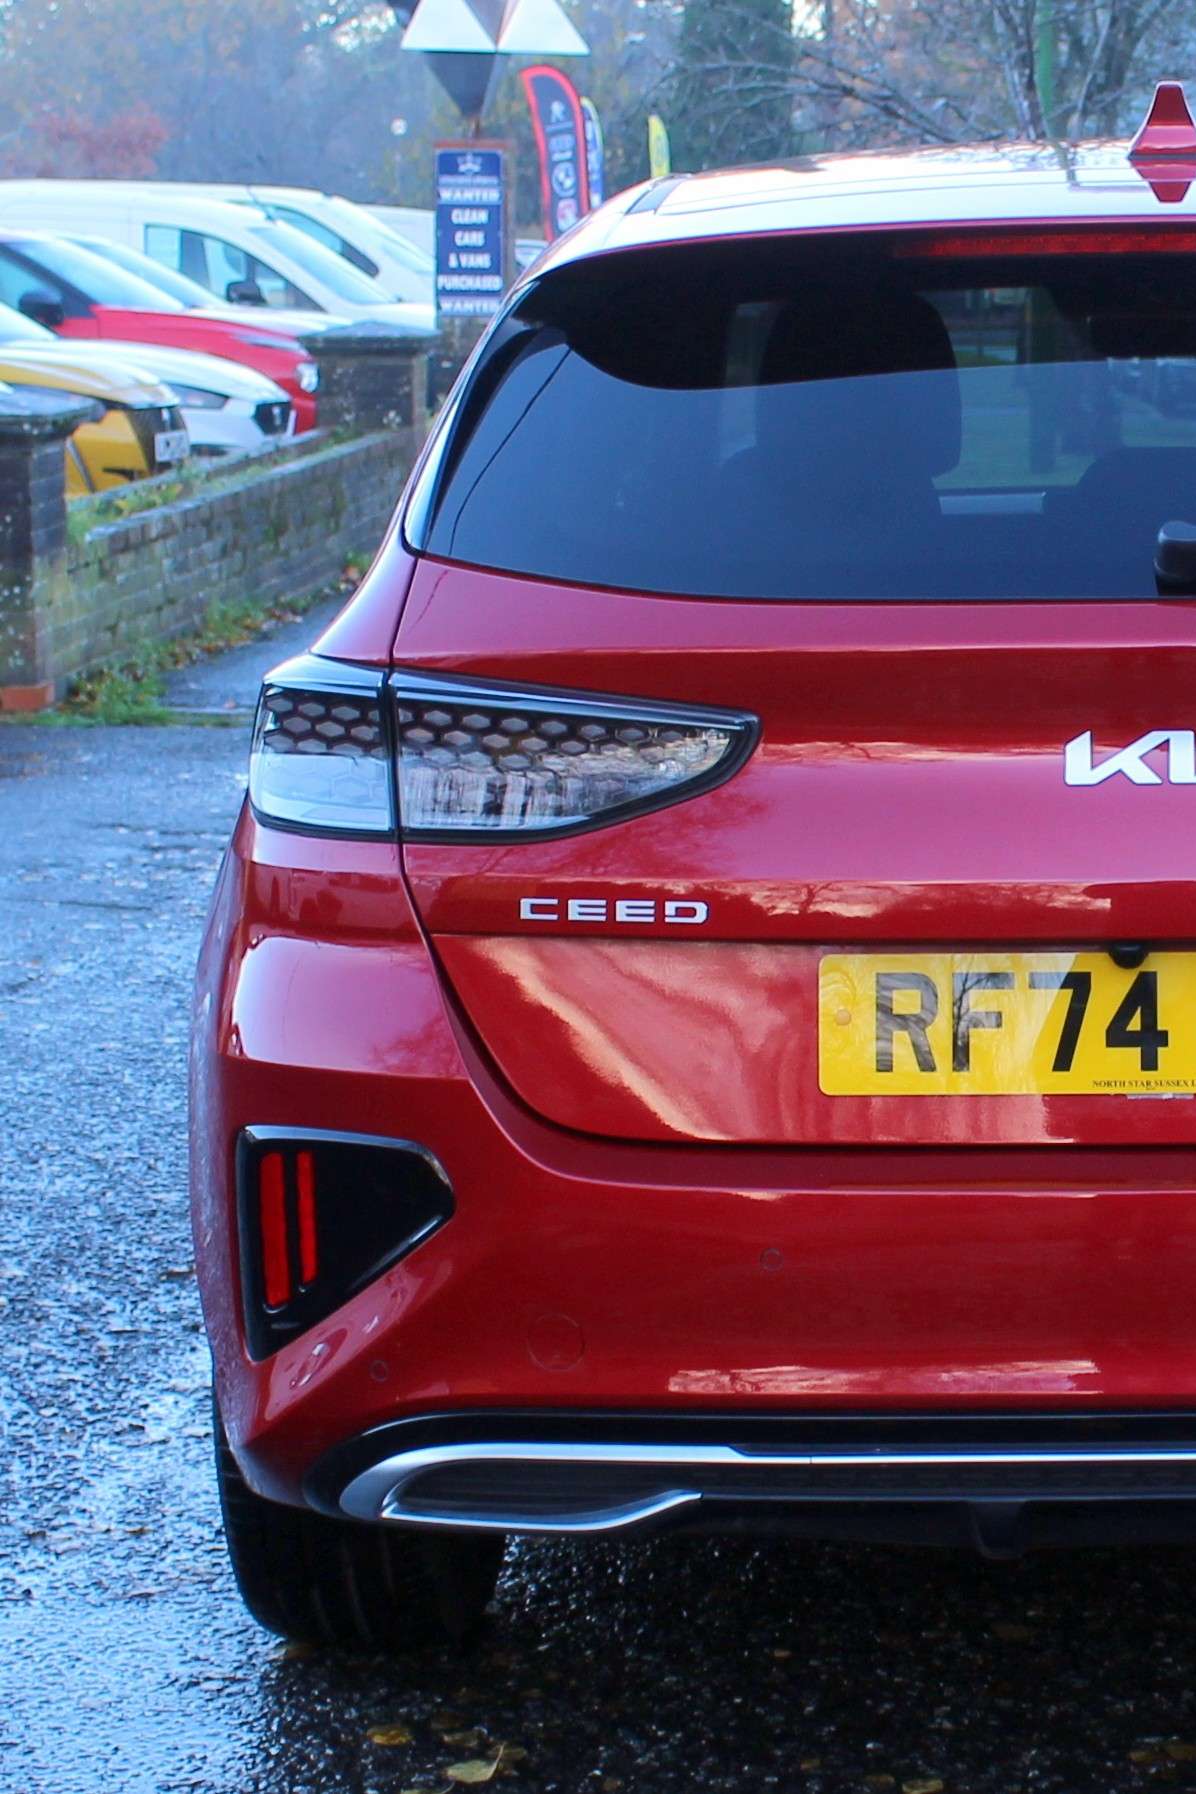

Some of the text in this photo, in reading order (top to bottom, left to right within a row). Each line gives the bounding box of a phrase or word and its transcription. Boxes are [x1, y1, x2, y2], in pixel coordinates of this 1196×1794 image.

[439, 189, 500, 201] WANTED
[451, 208, 489, 225] CLEAN
[454, 230, 486, 247] CARS
[459, 252, 491, 269] VANS
[437, 274, 503, 291] PURCHASED
[519, 898, 709, 924] CEED
[875, 970, 1169, 1073] RF74
[1092, 1079, 1126, 1088] NORTH
[1127, 1079, 1151, 1088] STAR
[1154, 1079, 1189, 1088] SUSSEX
